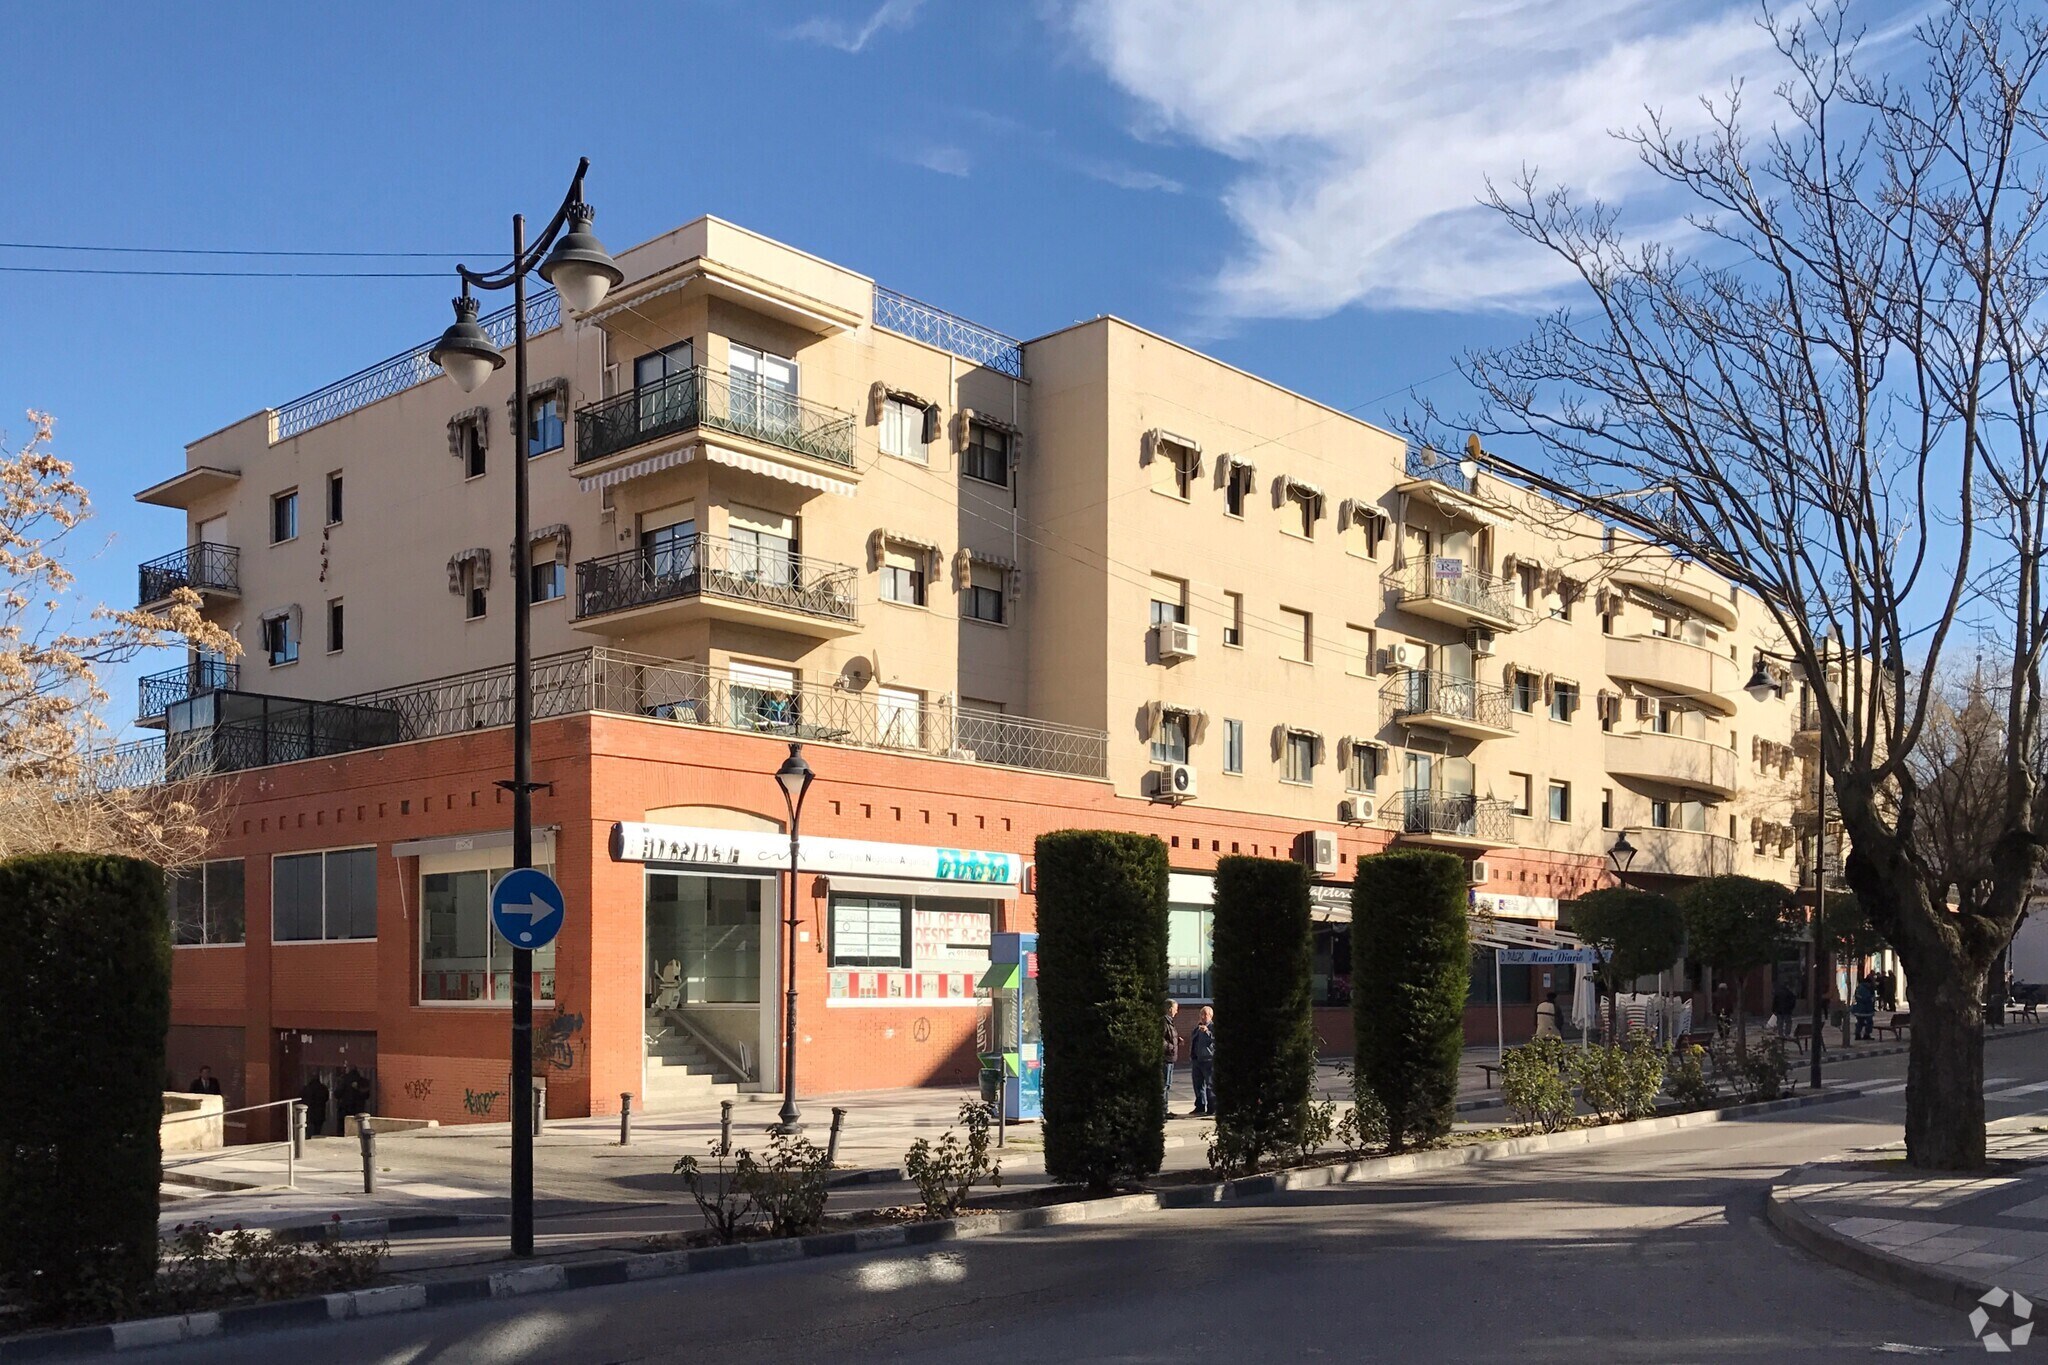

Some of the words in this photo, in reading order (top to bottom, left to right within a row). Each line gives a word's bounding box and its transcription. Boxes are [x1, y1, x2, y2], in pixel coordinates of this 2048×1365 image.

[915, 912, 931, 926] TU
[939, 912, 990, 928] OFICINA
[915, 927, 954, 943] DESDE
[915, 943, 938, 959] DIA
